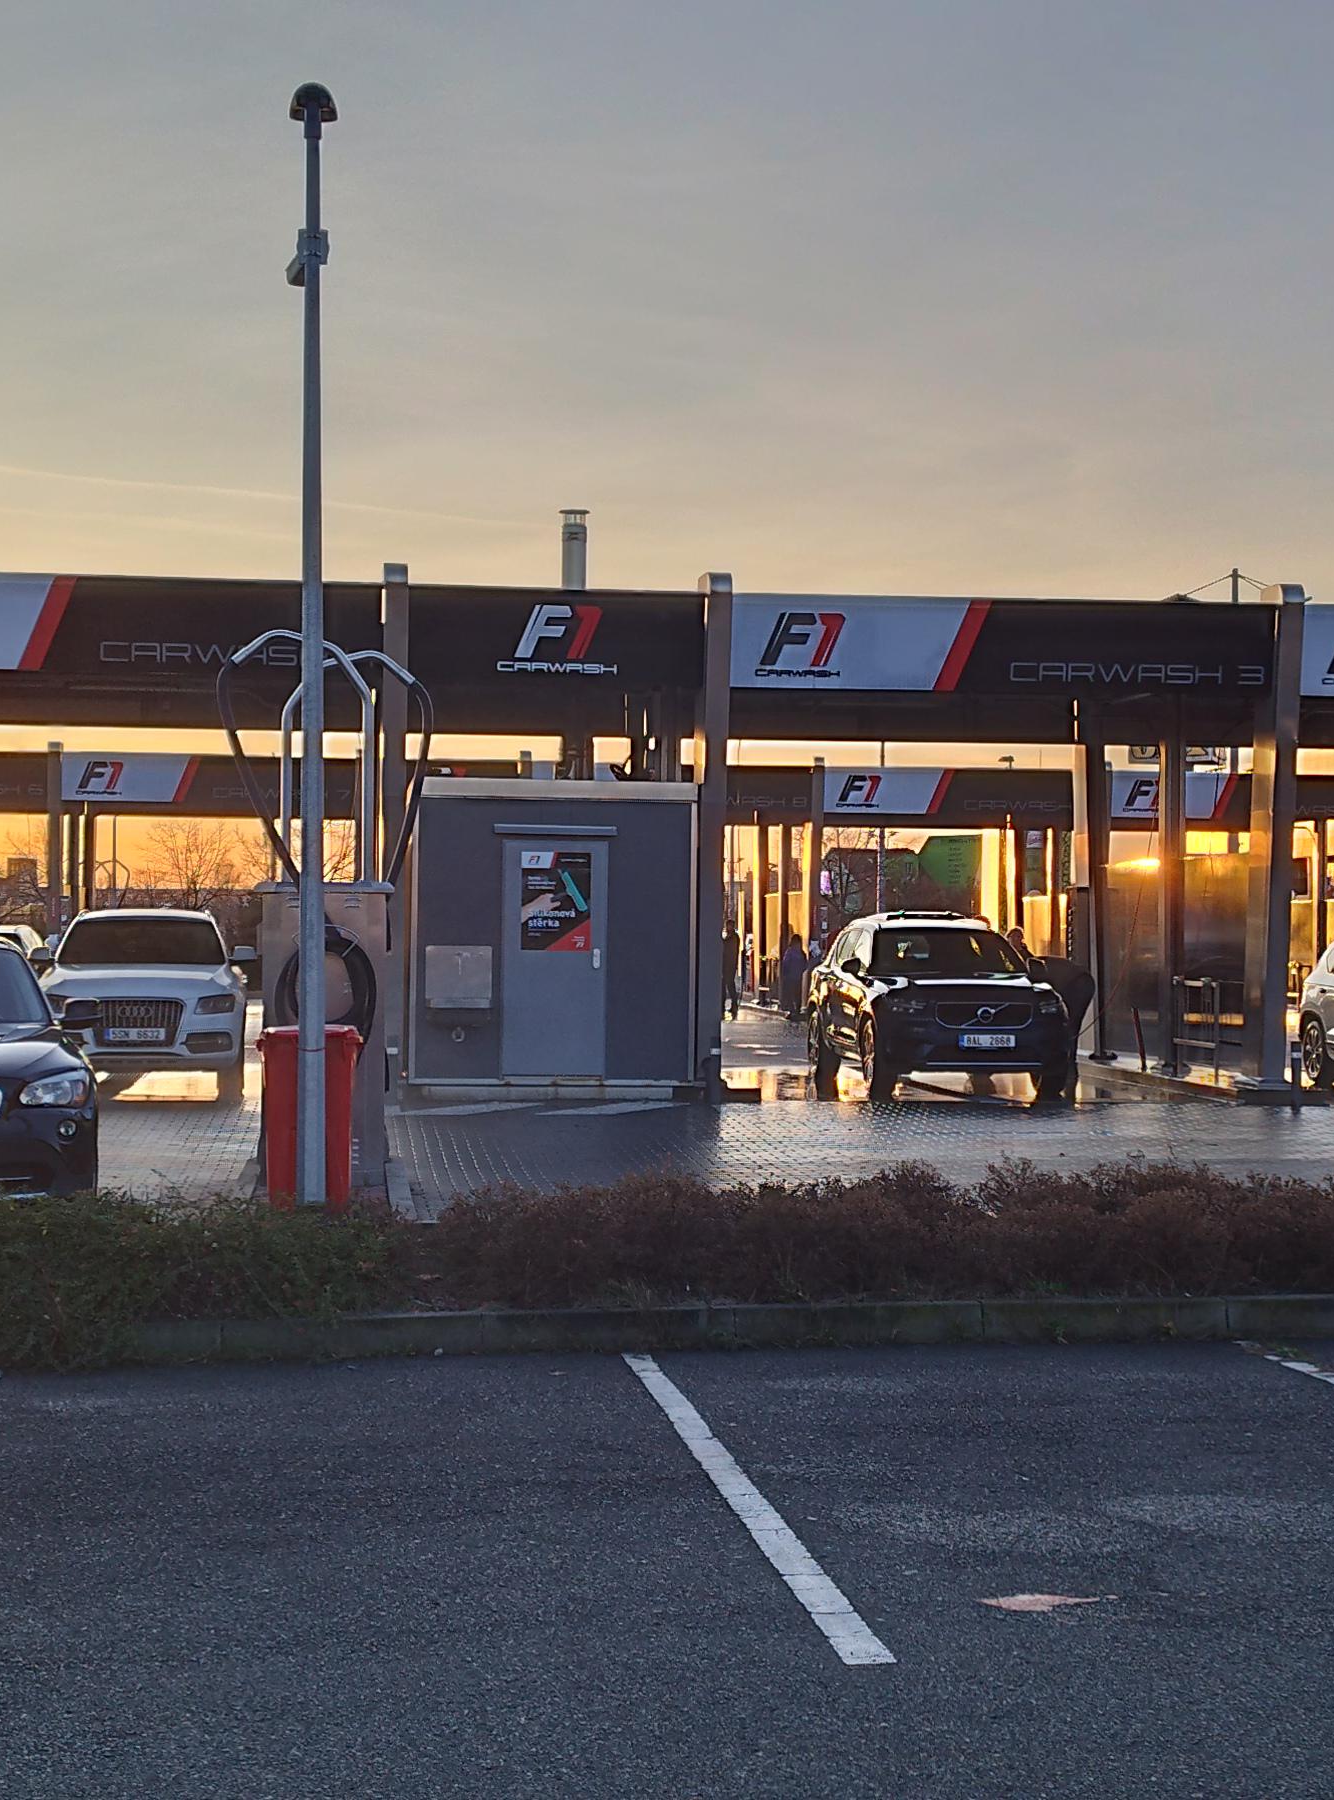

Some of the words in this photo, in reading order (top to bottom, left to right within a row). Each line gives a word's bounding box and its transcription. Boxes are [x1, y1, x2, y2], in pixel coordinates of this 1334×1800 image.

[514, 604, 603, 659] F1
[759, 611, 846, 667] F1
[99, 640, 300, 667] CARWAS
[496, 660, 617, 676] CARWASH
[755, 668, 840, 678] CARWASH
[1009, 661, 1223, 685] CARWASH
[1237, 665, 1265, 685] 3
[77, 760, 124, 789] F1
[837, 774, 882, 802] F1
[724, 796, 786, 807] WASH
[528, 918, 560, 927] stěrka
